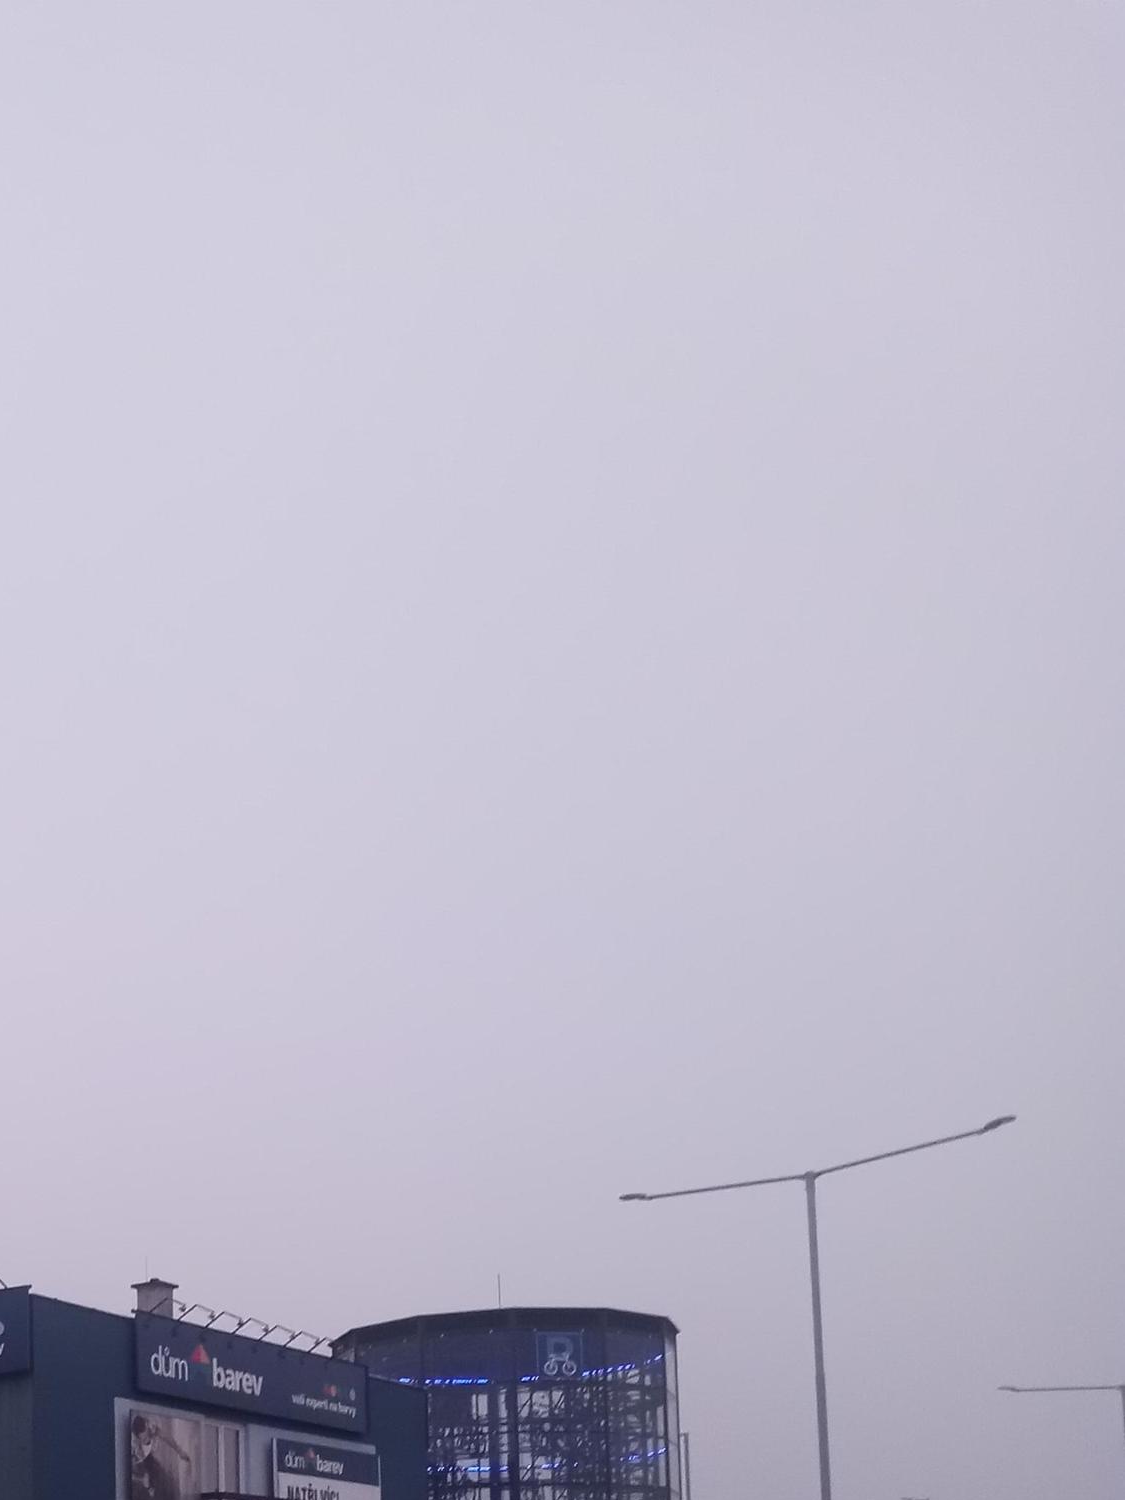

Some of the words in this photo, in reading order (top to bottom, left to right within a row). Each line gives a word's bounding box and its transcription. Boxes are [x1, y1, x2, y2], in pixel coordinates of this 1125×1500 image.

[150, 1345, 188, 1381] dům
[212, 1357, 263, 1396] barev
[329, 1401, 338, 1412] na
[316, 1453, 344, 1475] barev
